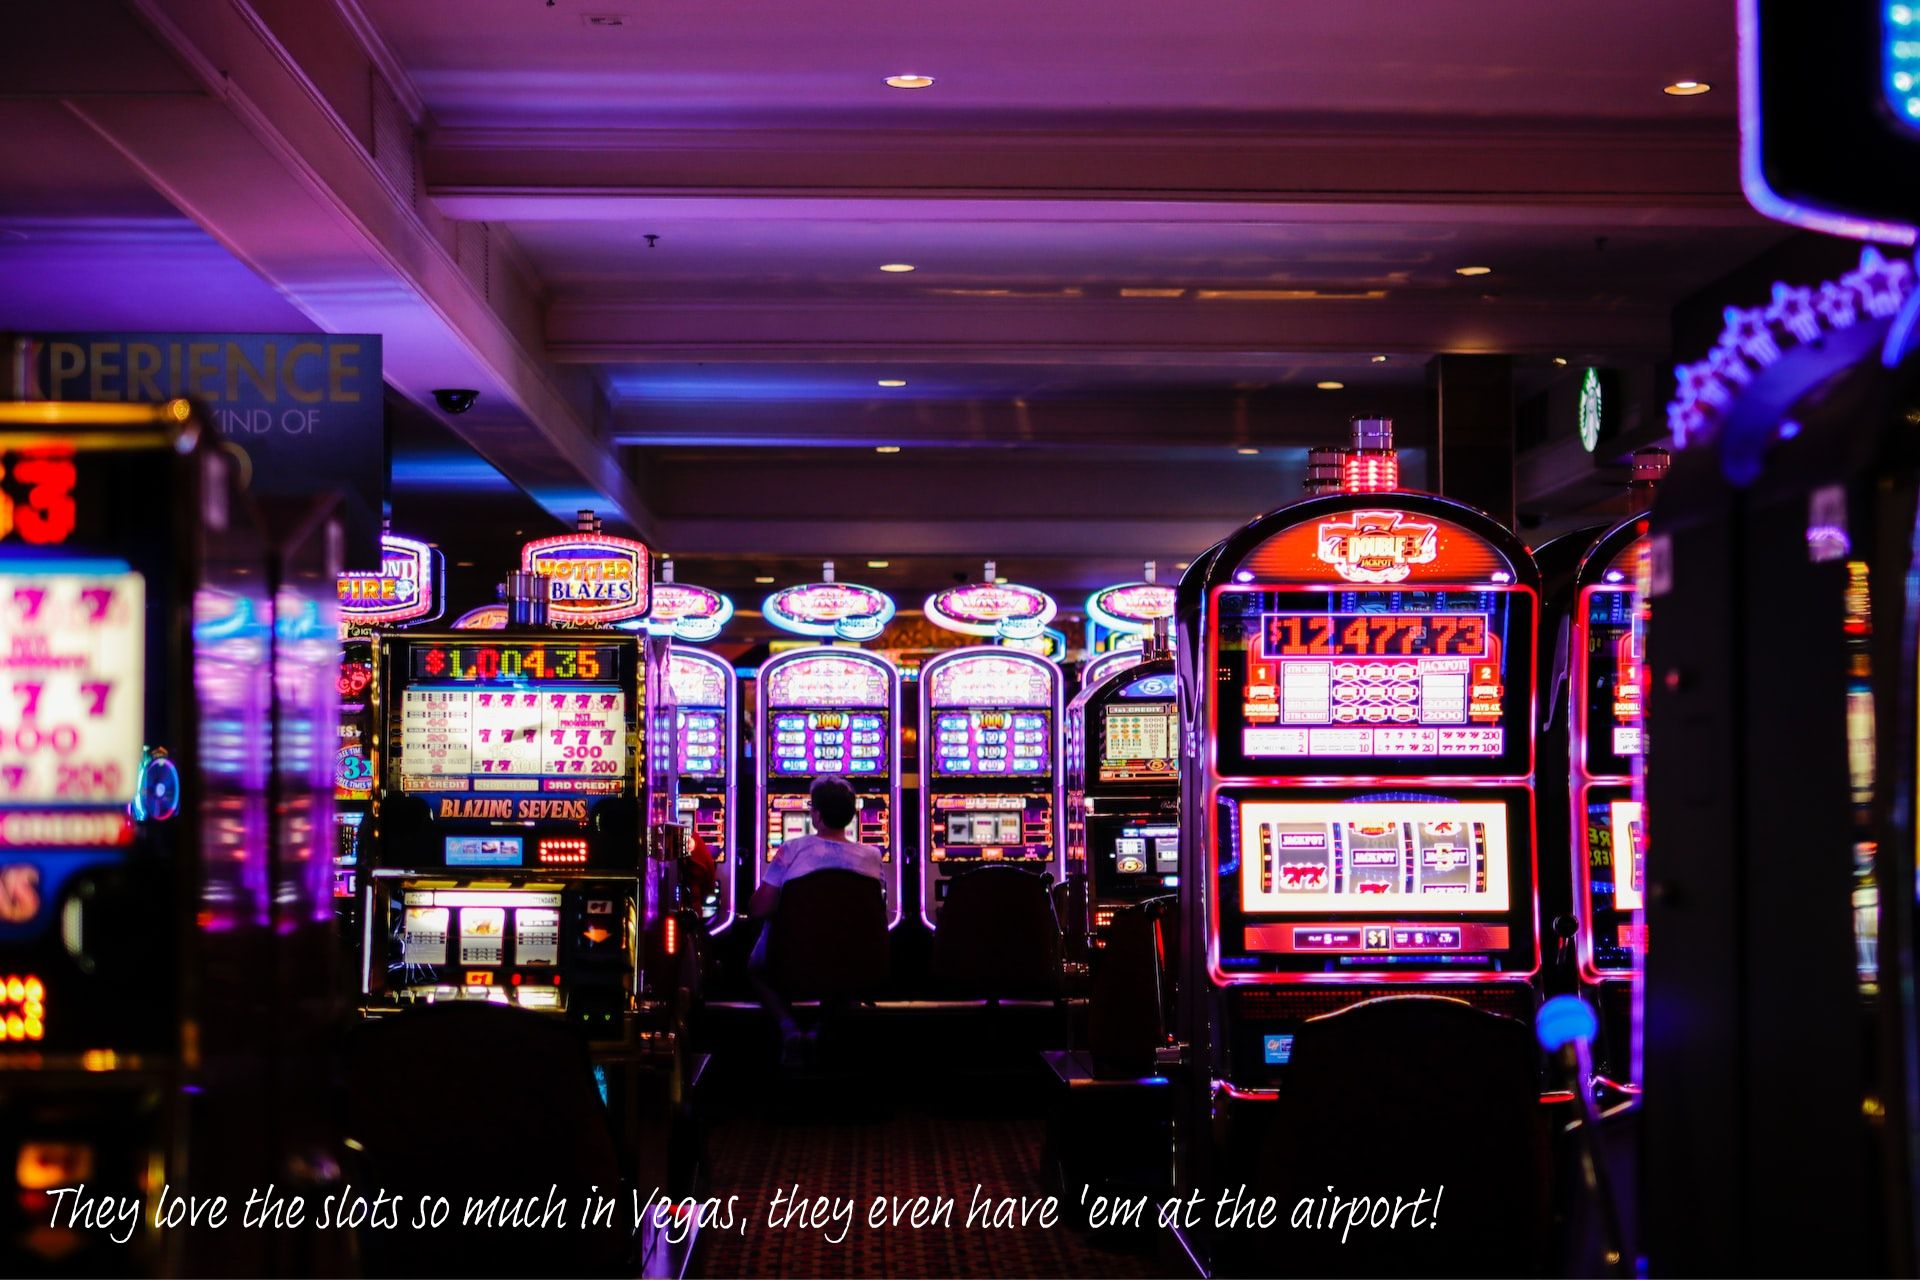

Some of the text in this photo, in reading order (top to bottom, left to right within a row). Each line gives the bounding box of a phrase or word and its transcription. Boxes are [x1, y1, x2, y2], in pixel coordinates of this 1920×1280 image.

[282, 409, 320, 434] OF
[1349, 536, 1406, 564] DOUBLE
[1362, 558, 1392, 567] JACKPOT
[536, 559, 632, 581] HOTTER
[337, 579, 395, 599] FIRE
[552, 582, 631, 600] BLAZES
[1270, 616, 1484, 655] $12,477.73
[425, 648, 599, 678] $1,004.35
[1258, 668, 1265, 679] 1
[1481, 667, 1492, 679] 2
[563, 745, 603, 759] 300
[1482, 743, 1500, 753] 100
[591, 760, 618, 773] 200
[428, 780, 466, 789] CREDIT
[548, 781, 617, 790] 3RD CREDIT
[440, 799, 587, 819] BLAZING SEVENS
[1282, 835, 1324, 846] JACKPOT
[1355, 853, 1396, 863] JACKPOT
[1368, 929, 1386, 947] $1
